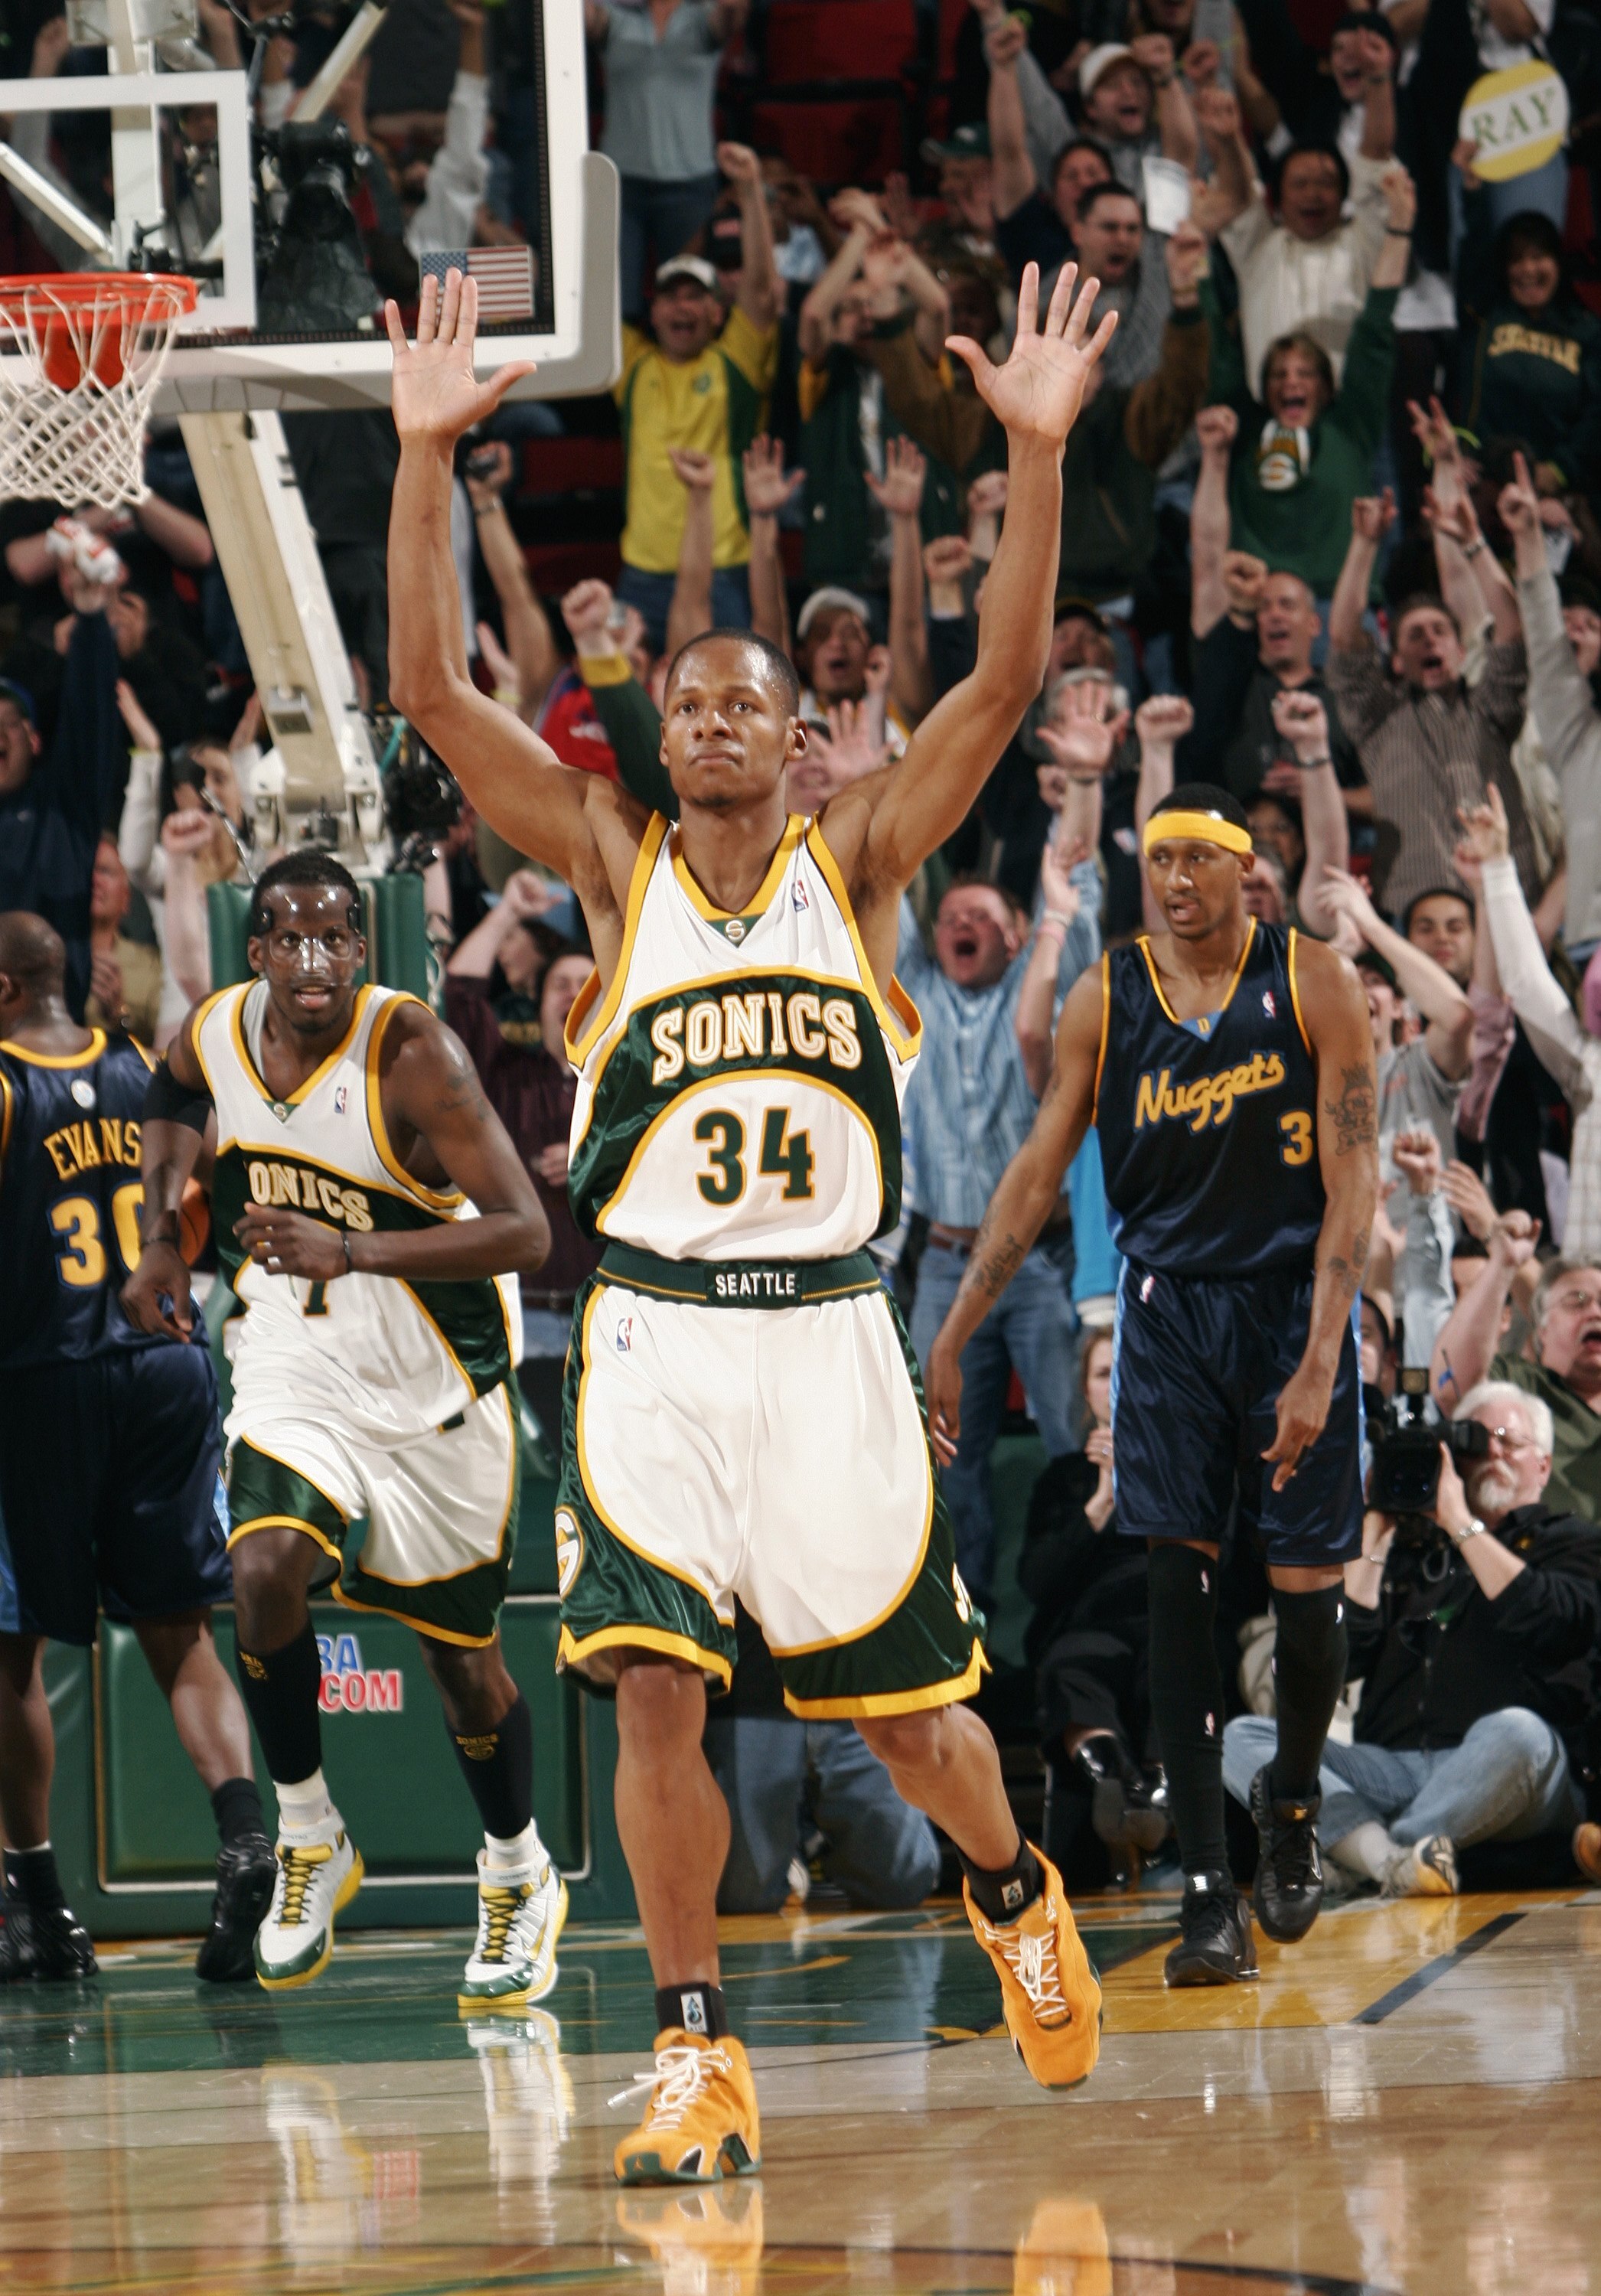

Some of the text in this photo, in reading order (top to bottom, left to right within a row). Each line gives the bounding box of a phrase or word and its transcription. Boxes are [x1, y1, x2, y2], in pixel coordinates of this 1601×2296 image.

[1472, 87, 1555, 147] RAY
[651, 993, 862, 1087] SONICS
[1133, 1052, 1286, 1133] Nuggets
[43, 1117, 142, 1180] EVANS
[693, 1105, 815, 1208] 34
[1279, 1110, 1314, 1166] 3
[246, 1160, 374, 1232] ONICS
[715, 1272, 797, 1297] SEATTLE
[318, 1669, 403, 1713] COM
